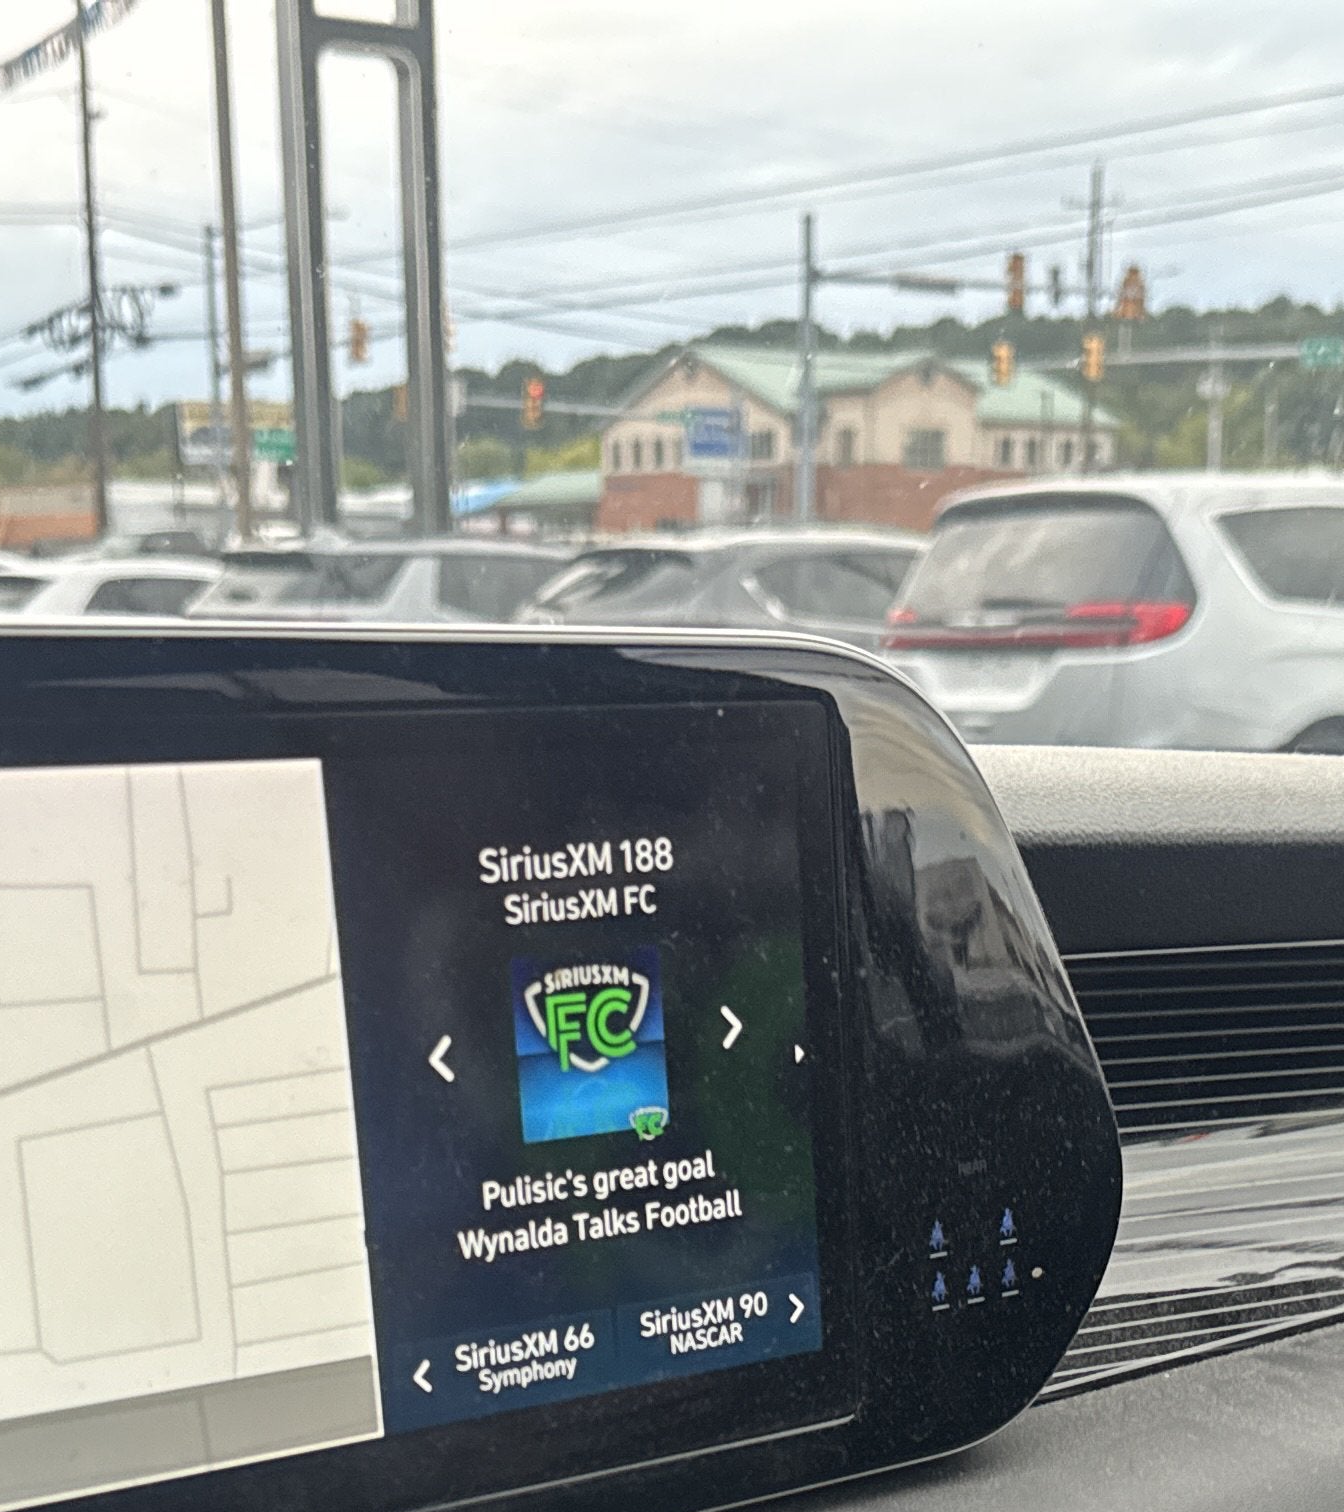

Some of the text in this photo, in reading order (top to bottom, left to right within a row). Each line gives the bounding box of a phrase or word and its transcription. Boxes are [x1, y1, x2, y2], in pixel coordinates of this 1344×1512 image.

[478, 837, 674, 884] SiriusXM 188
[504, 884, 657, 926] SiriusXM FC
[544, 963, 629, 994] SIRIUSXM
[545, 987, 637, 1073] FC
[482, 1149, 716, 1211] Pulisic's great goal
[457, 1189, 743, 1263] Wynalda Talks Football
[639, 1291, 769, 1338] SiriusXM 90
[455, 1323, 595, 1373] SiriusXM 66
[669, 1322, 744, 1355] NASCAR
[478, 1356, 578, 1393] Symphony
